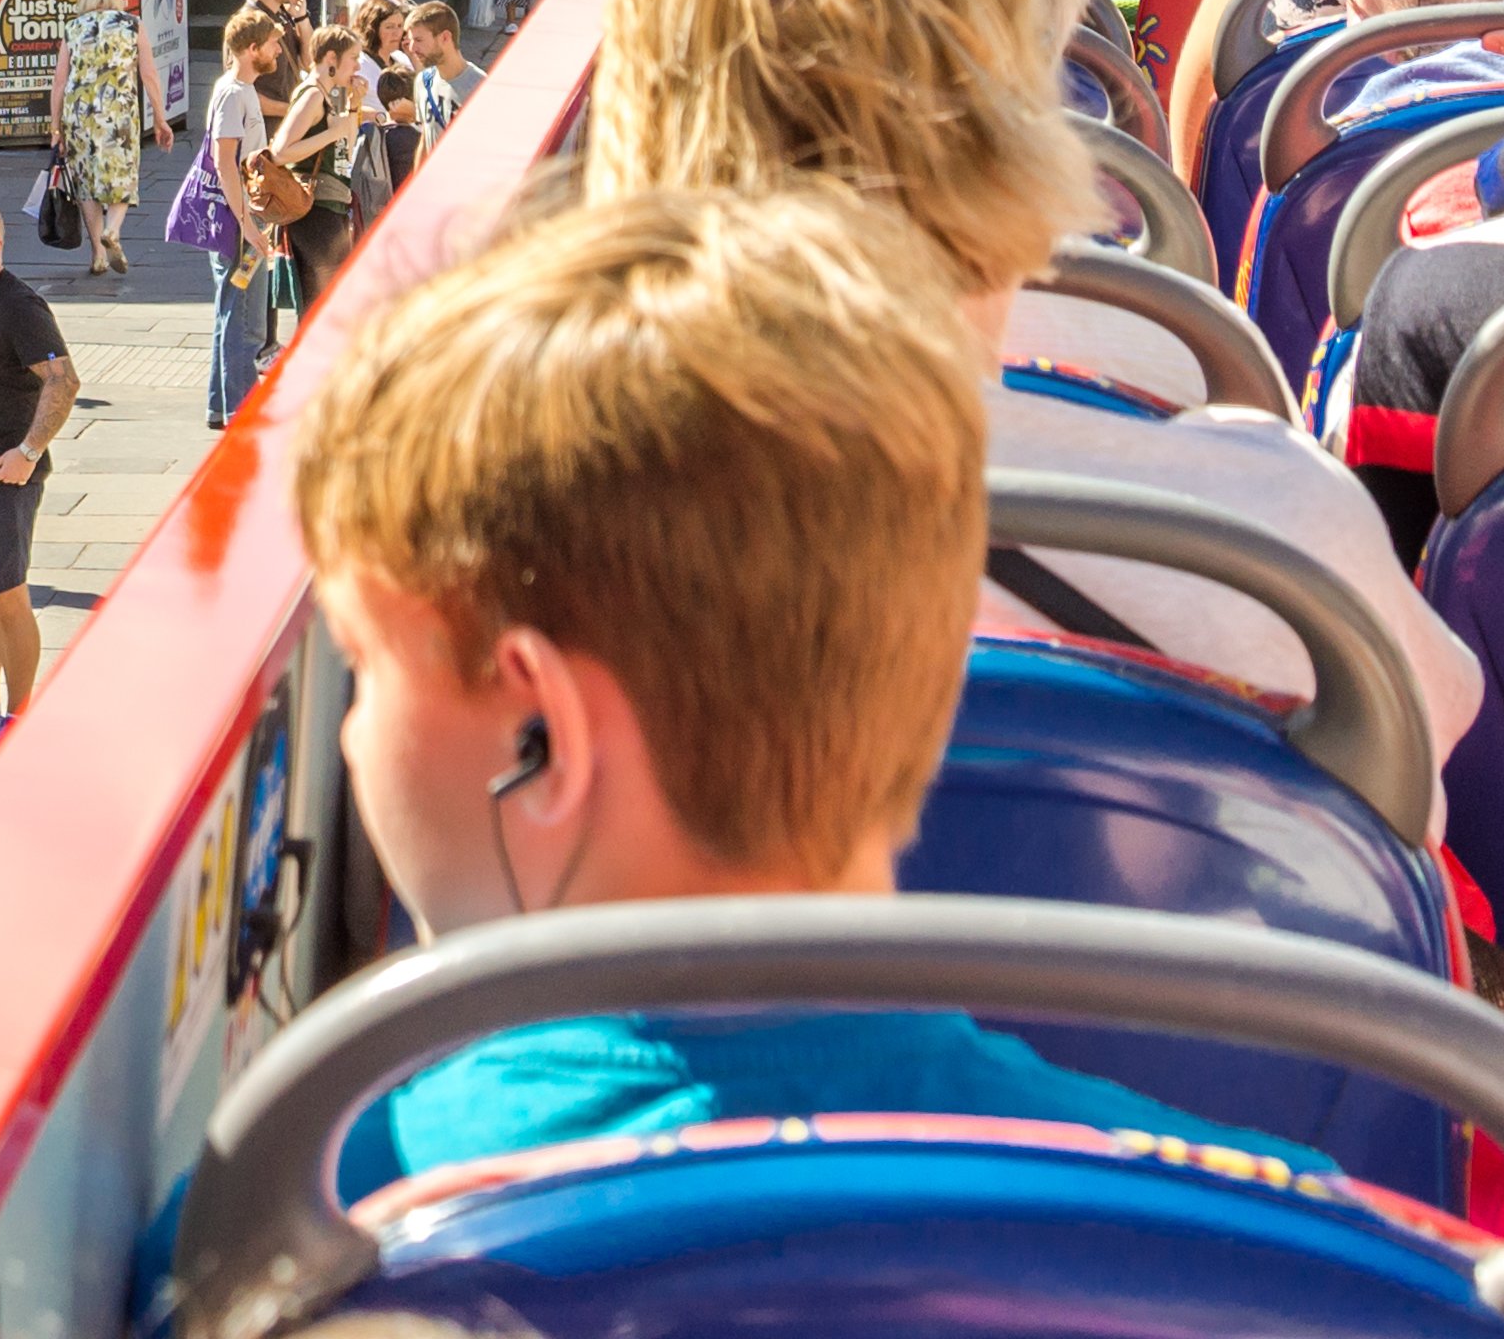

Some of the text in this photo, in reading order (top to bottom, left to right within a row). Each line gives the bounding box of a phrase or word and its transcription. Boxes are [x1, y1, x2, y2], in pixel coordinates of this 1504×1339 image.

[57, 0, 79, 14] the
[8, 14, 65, 41] Toni
[11, 41, 53, 51] COMEDY
[8, 54, 56, 69] EDINBU
